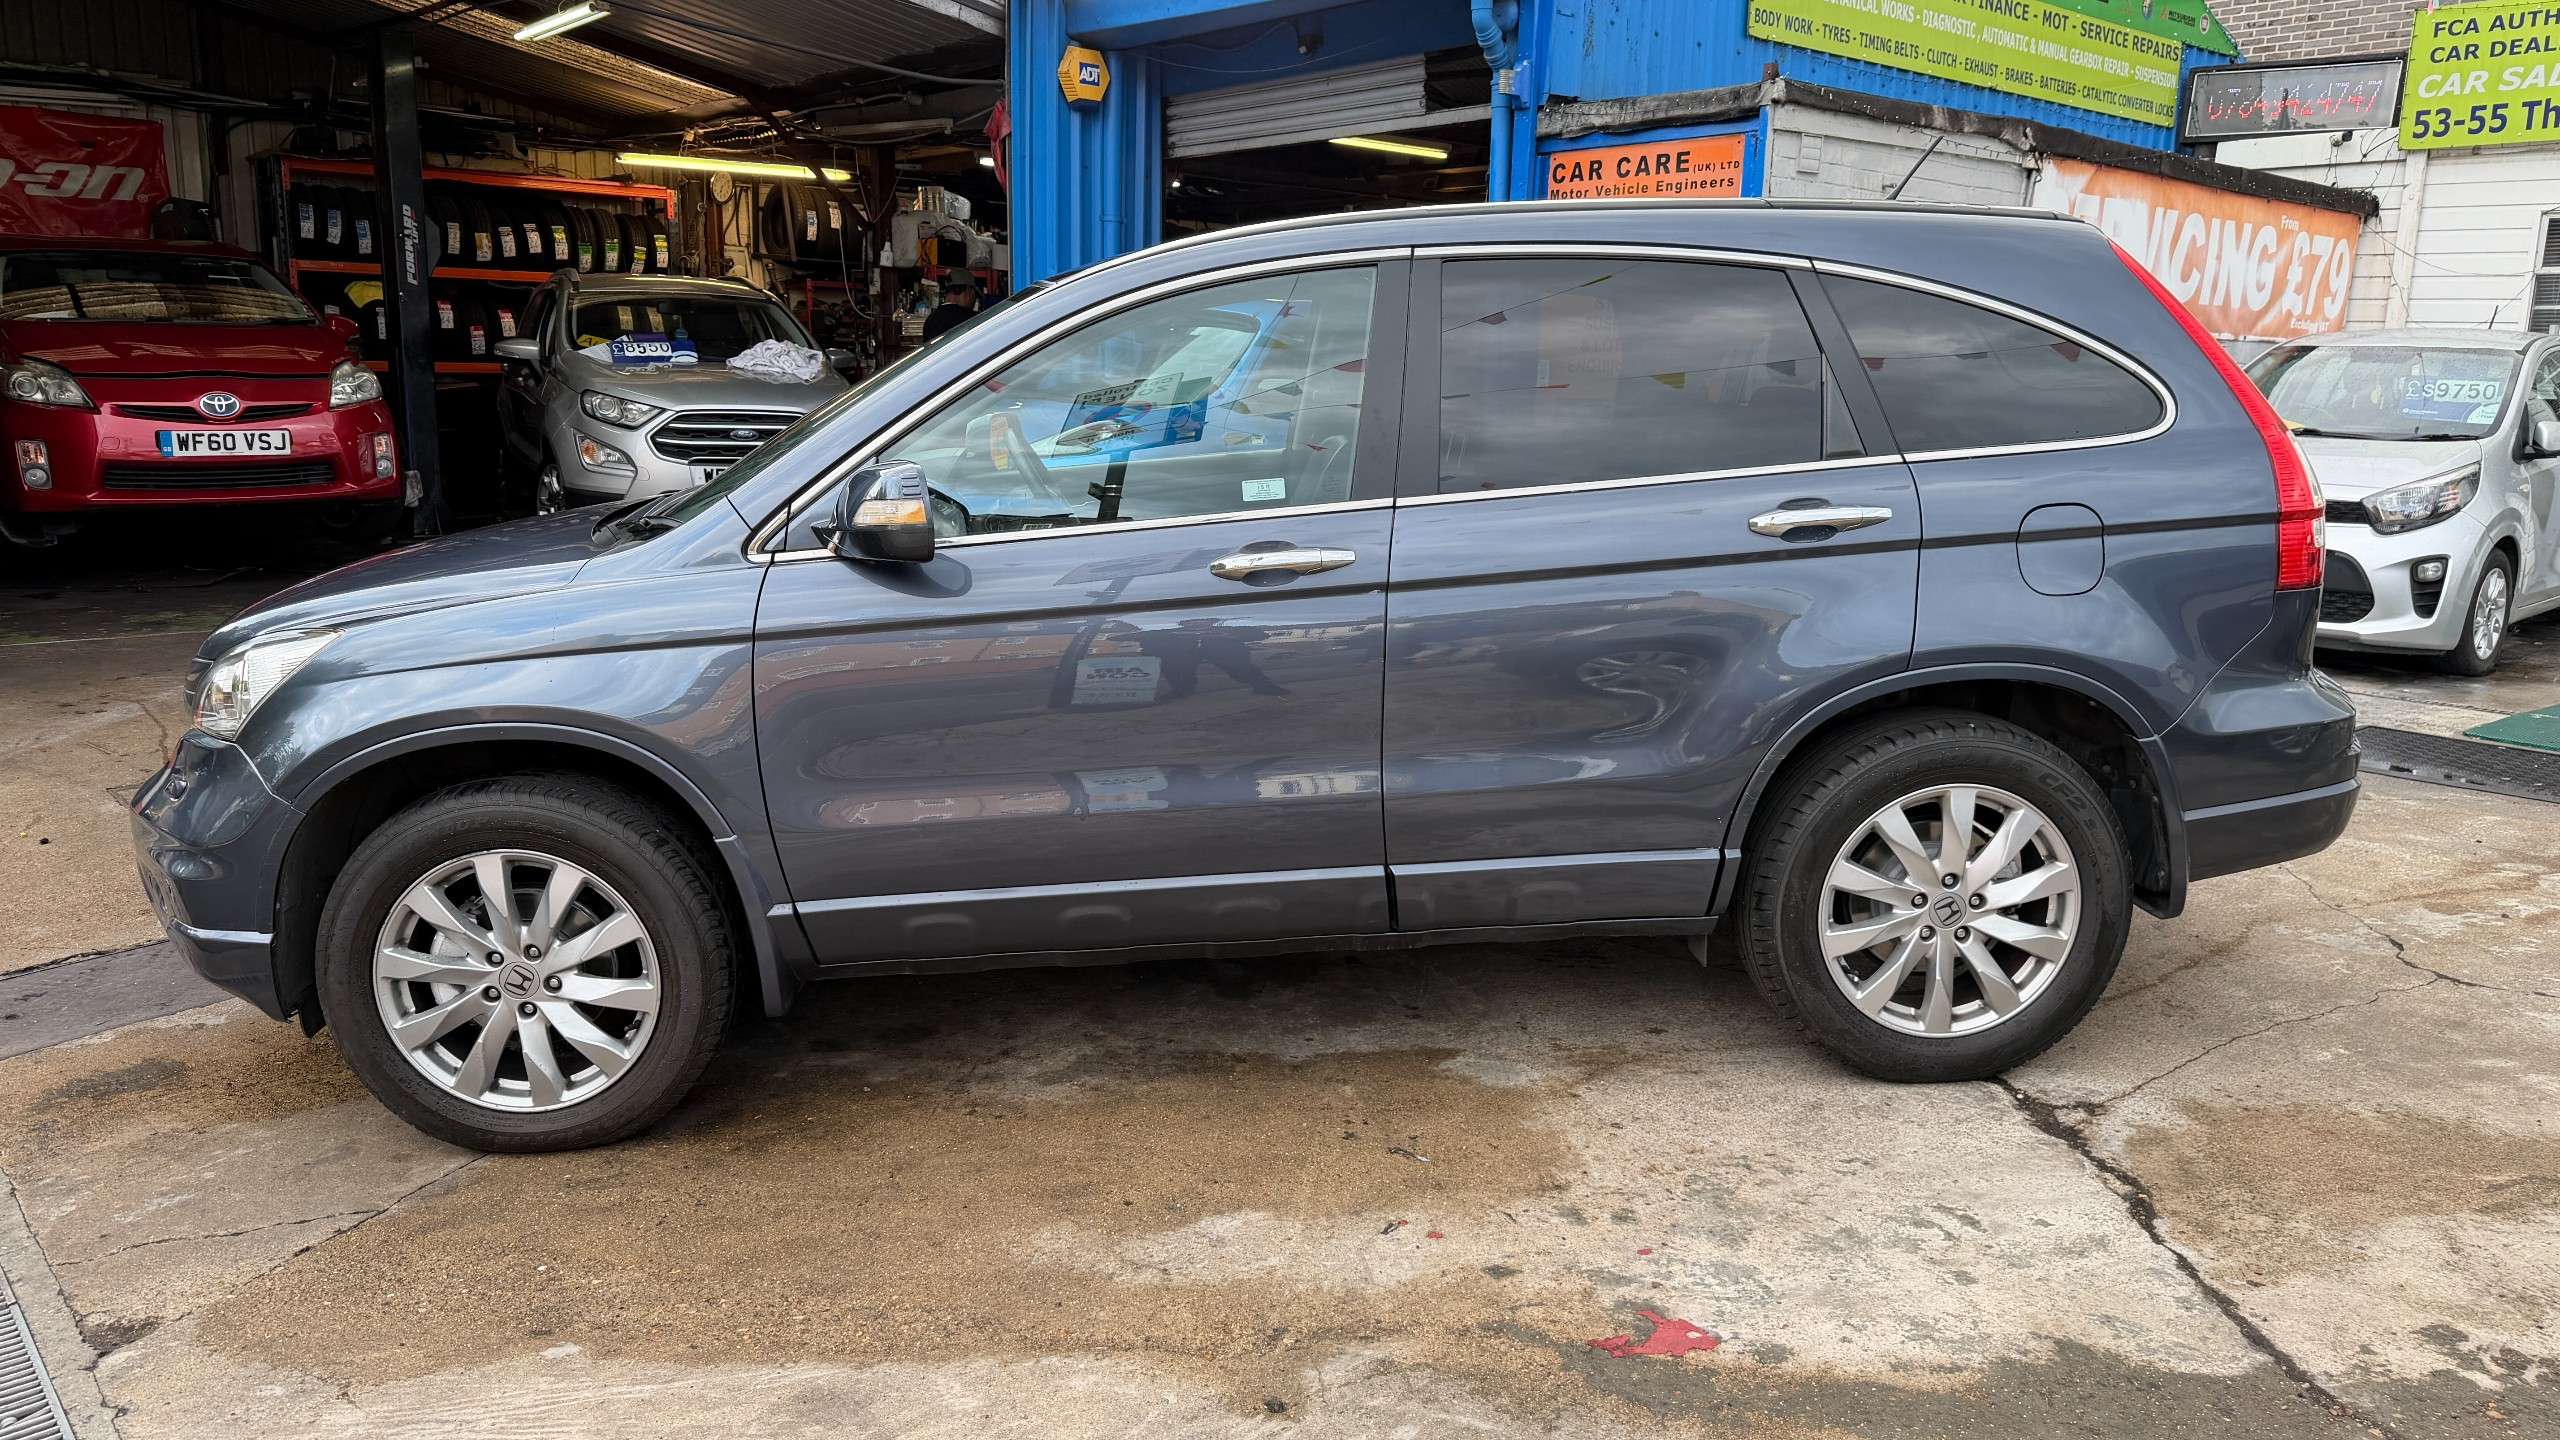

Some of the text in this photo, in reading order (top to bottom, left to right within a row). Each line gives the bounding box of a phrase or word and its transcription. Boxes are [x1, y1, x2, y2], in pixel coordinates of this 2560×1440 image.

[2042, 11, 2069, 32] MOT
[2080, 20, 2129, 49] SERVICE
[2132, 35, 2179, 62] REPAIRS
[2434, 18, 2480, 38] FCA
[1880, 0, 1915, 23] WORKS
[1922, 9, 1976, 40] DIAGNOSTIC
[1981, 26, 2028, 52] AUTOMATIC
[2030, 38, 2036, 52] &
[2038, 39, 2069, 63] MANUAL
[2070, 50, 2102, 70] GEARBOX
[2104, 58, 2129, 78] REPAIR
[2135, 67, 2177, 89] SUSPENSION
[2430, 35, 2560, 63] CAR DEAL
[1080, 66, 1100, 82] ADT
[1754, 8, 1781, 28] BODY
[1785, 15, 1813, 36] WORK
[1822, 24, 1850, 44] TYRES
[1859, 32, 1892, 54] TIMING
[1894, 40, 1919, 60] BELTS
[1926, 50, 1957, 68] CLUTCH
[1964, 57, 1998, 78] EXHAUST
[2004, 68, 2033, 86] BRAKES
[2040, 75, 2076, 96] BATTERIES
[2082, 85, 2117, 104] CATALYTIC
[2118, 93, 2154, 114] CONVERTER
[2155, 101, 2174, 118] LOCKS
[2418, 70, 2489, 99] CAR
[2412, 102, 2509, 139] 53-55
[0, 158, 145, 201] -on
[1552, 151, 1740, 185] CAR CARE (UK) LTD
[1550, 176, 1734, 200] Motor Vehicle Engineers
[2281, 215, 2299, 231] From
[2282, 231, 2350, 319] £79
[176, 433, 286, 451] WF60 VSJ
